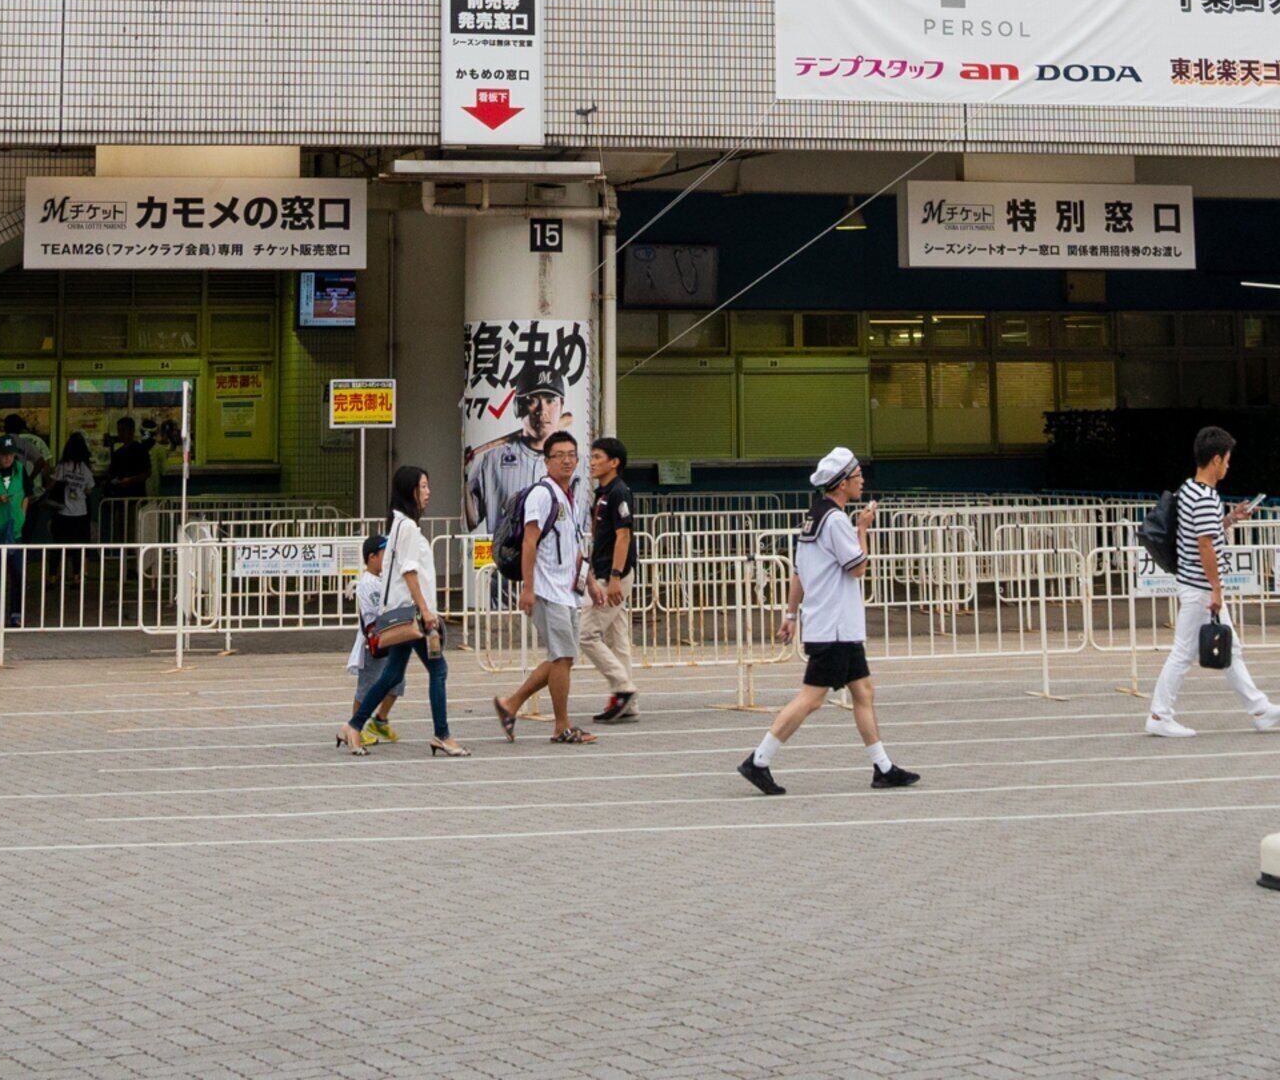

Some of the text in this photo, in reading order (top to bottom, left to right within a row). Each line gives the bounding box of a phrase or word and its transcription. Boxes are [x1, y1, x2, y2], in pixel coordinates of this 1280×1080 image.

[458, 12, 528, 30] 発売窓口
[923, 18, 1031, 38] PERSOL
[455, 68, 530, 81] かもめの窓口
[794, 55, 1142, 83] テンプスタッフ an DODA
[478, 92, 508, 103] 看板下
[135, 195, 351, 231] カモメの窓口
[1006, 198, 1181, 233] 特別窓口
[533, 223, 560, 247] 15
[253, 243, 351, 257] チケット販売窓口
[924, 243, 1060, 256] シーズンシートオーナー窓口
[216, 375, 262, 390] 完売御礼
[334, 393, 392, 411] 完売御礼
